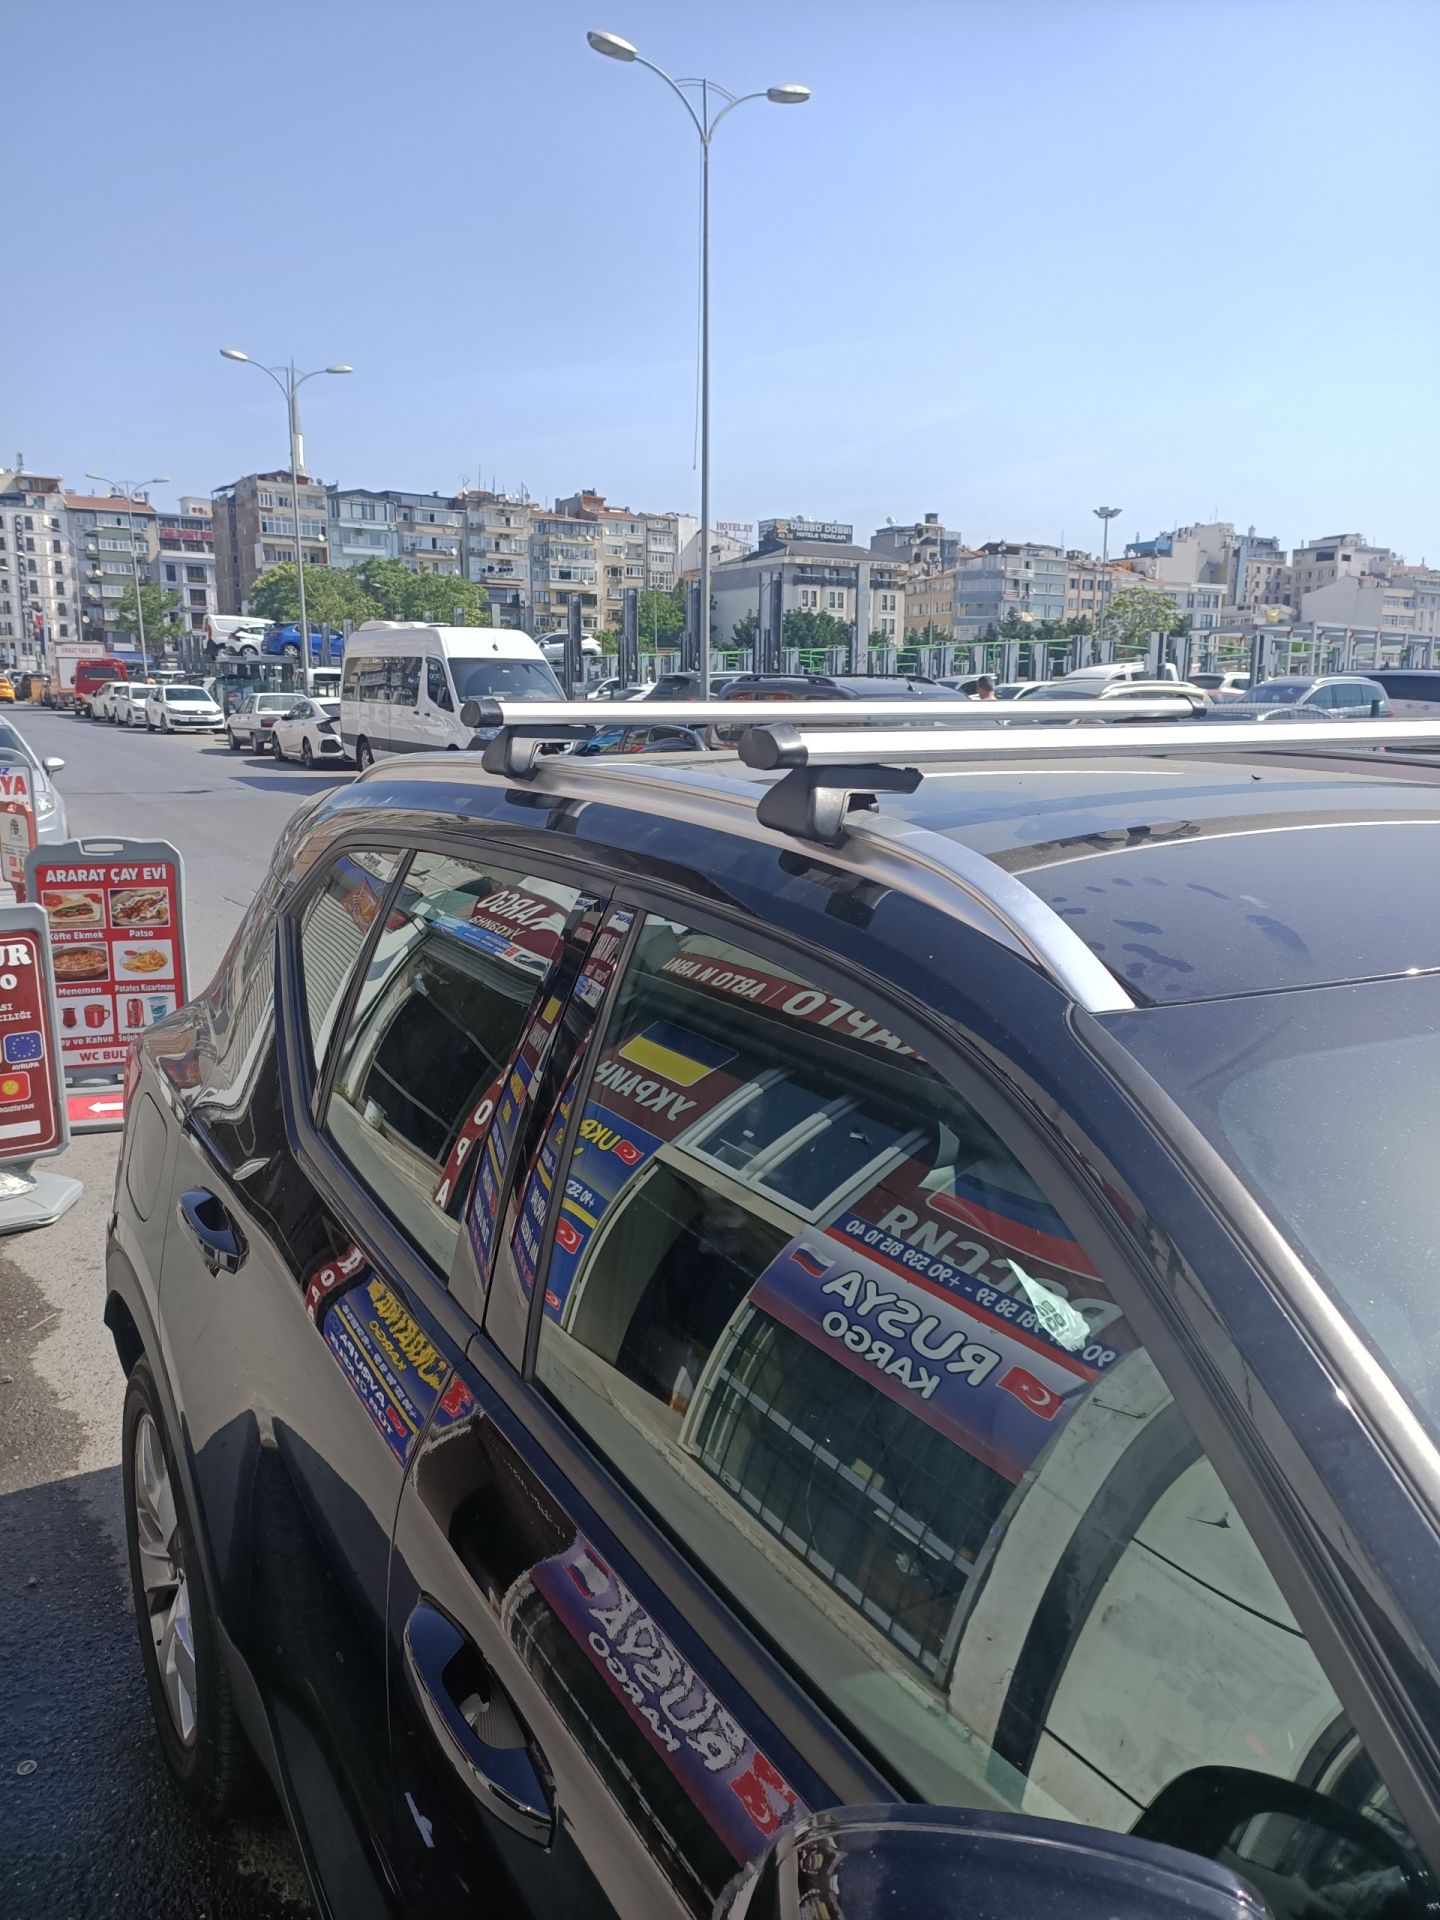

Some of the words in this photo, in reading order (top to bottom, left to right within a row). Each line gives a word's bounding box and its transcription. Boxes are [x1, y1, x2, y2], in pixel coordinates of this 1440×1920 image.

[45, 868, 106, 883] ARARAT
[110, 867, 139, 884] ÇAY
[143, 864, 168, 880] EVİ
[74, 931, 105, 939] Ekmek
[58, 987, 102, 996] Menemen
[114, 984, 140, 992] Patates
[60, 1038, 73, 1047] ay
[86, 1035, 113, 1044] Kahve
[80, 1051, 99, 1061] WC
[103, 1049, 127, 1060] BUL
[11, 1062, 40, 1071] AVRUPA
